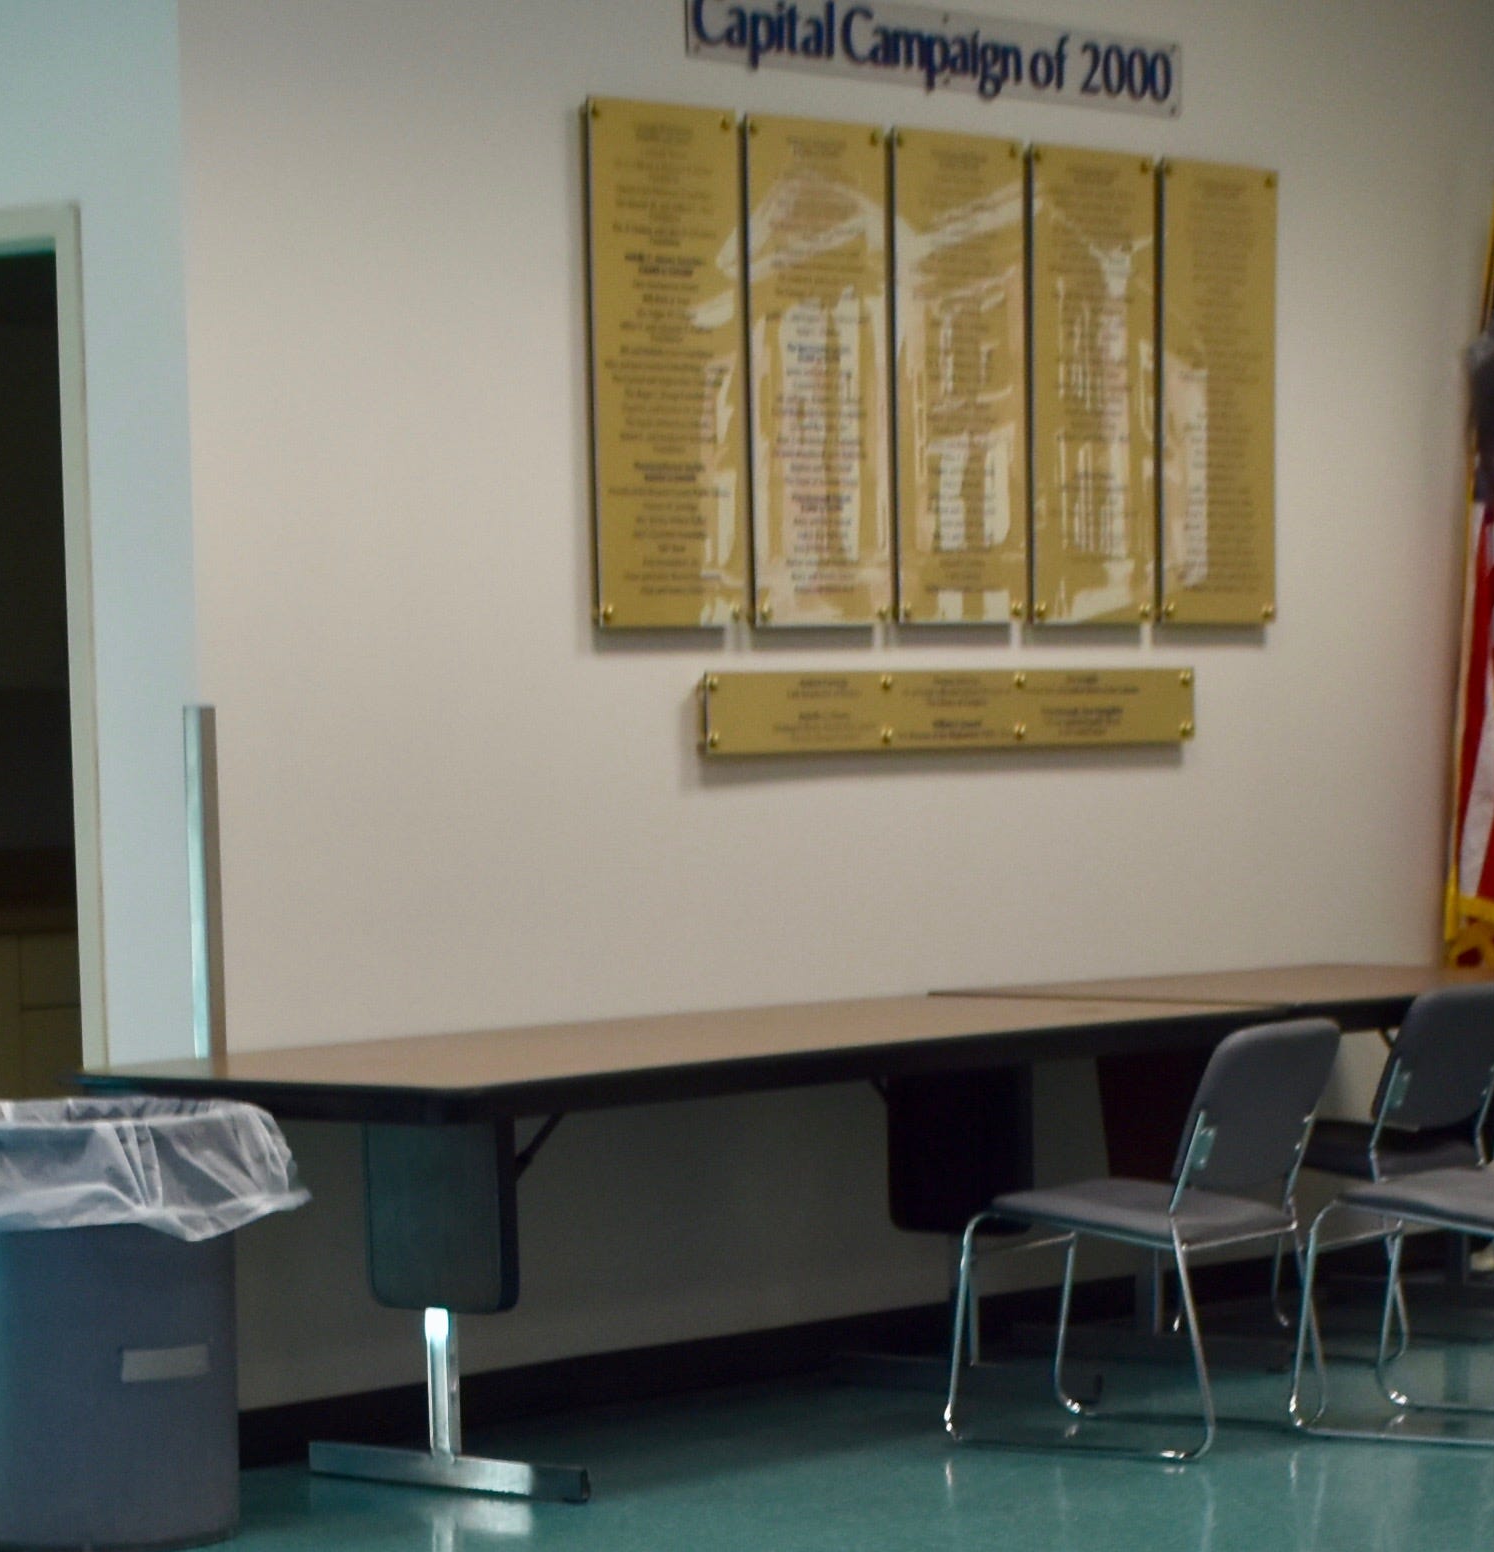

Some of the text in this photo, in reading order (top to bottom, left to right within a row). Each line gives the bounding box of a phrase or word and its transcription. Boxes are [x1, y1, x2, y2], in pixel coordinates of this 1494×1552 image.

[692, 0, 1173, 102] Capital Campaign of 2000
